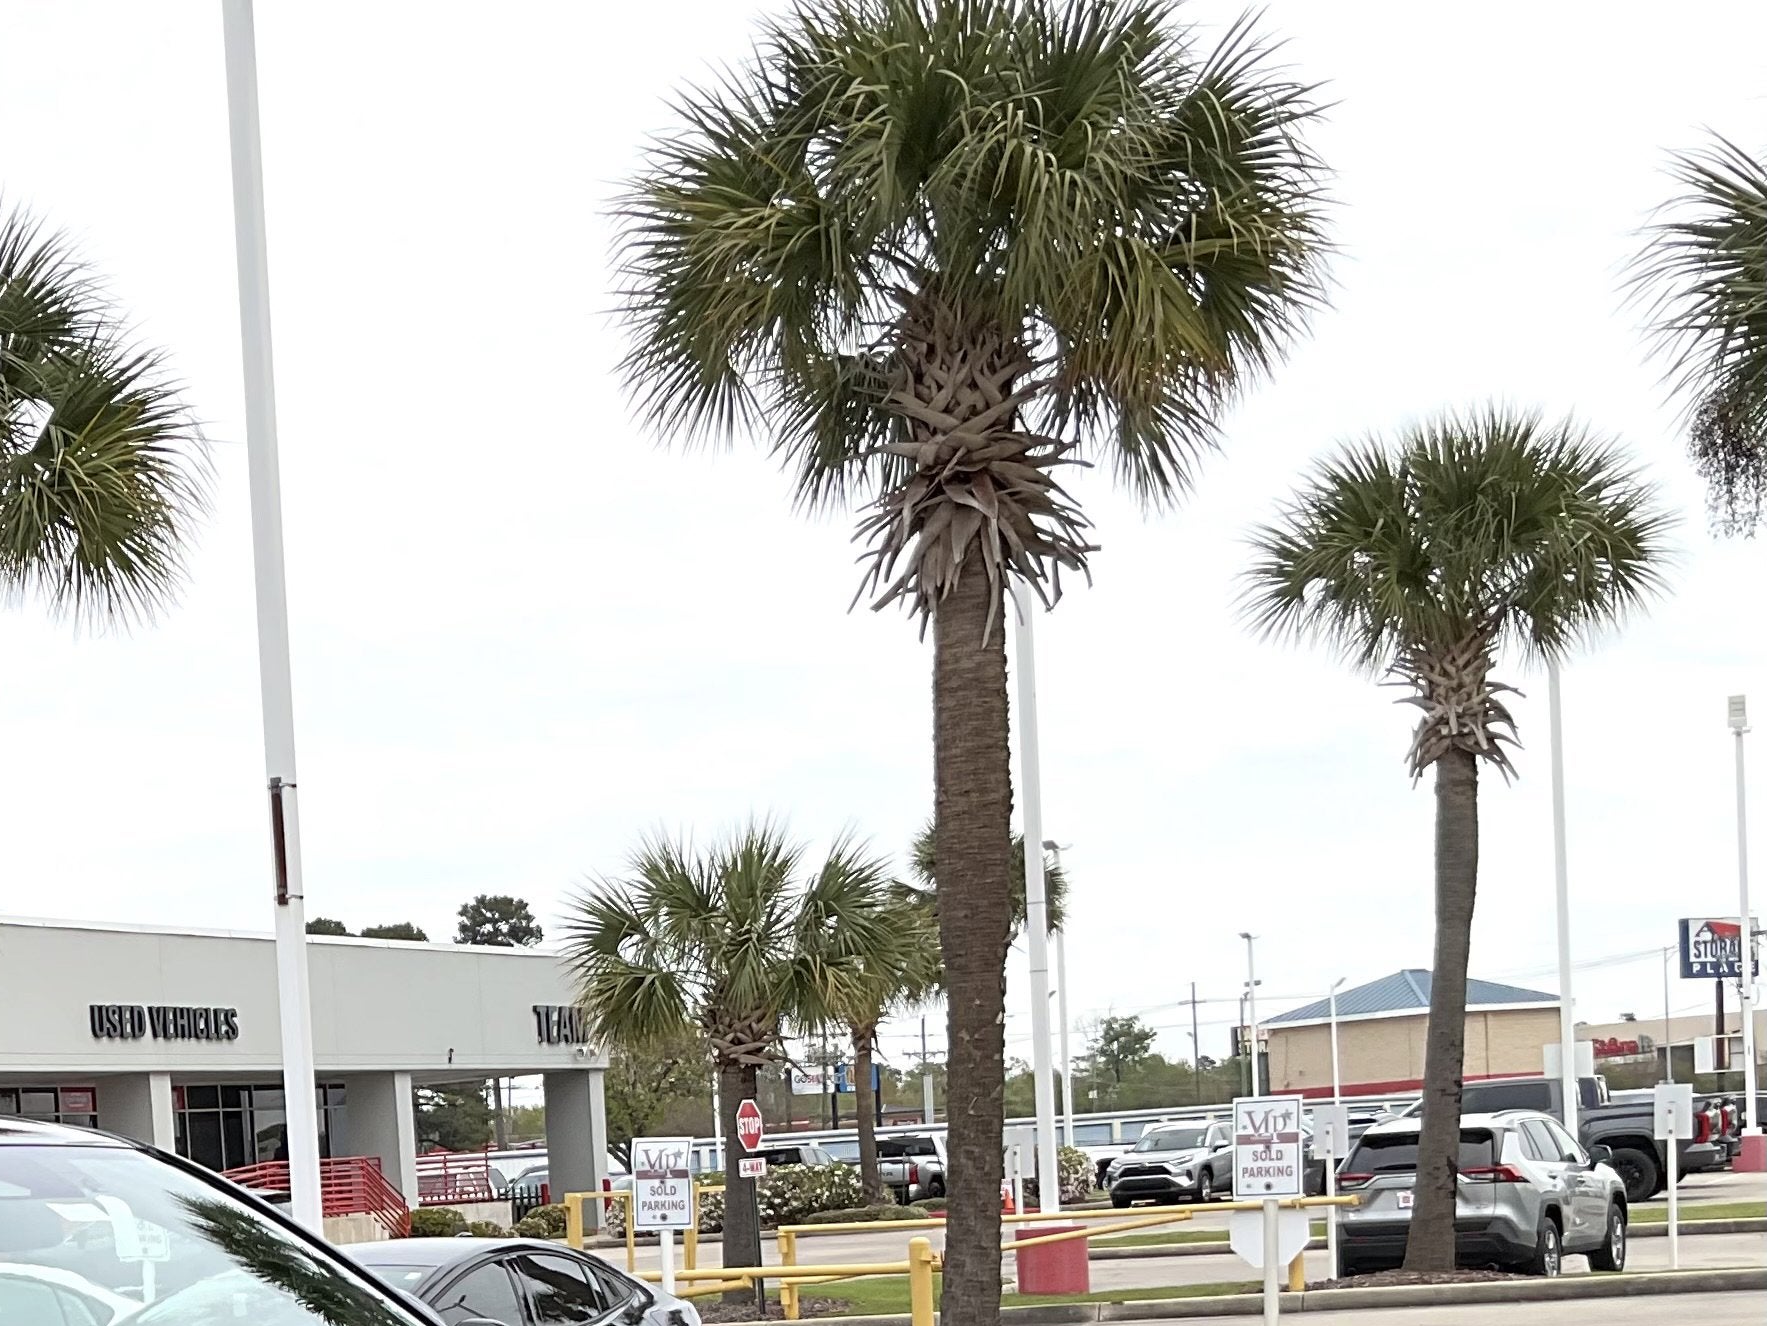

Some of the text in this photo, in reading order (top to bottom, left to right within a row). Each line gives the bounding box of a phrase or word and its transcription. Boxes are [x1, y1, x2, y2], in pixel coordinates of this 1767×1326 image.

[89, 1004, 240, 1041] USED VEHICLES
[738, 1116, 760, 1135] STOP
[1252, 1149, 1284, 1162] SOLD
[742, 1161, 763, 1173] 4-WAY
[1242, 1165, 1294, 1178] PARKING
[649, 1185, 677, 1197] SOLD
[641, 1200, 686, 1211] PARKING
